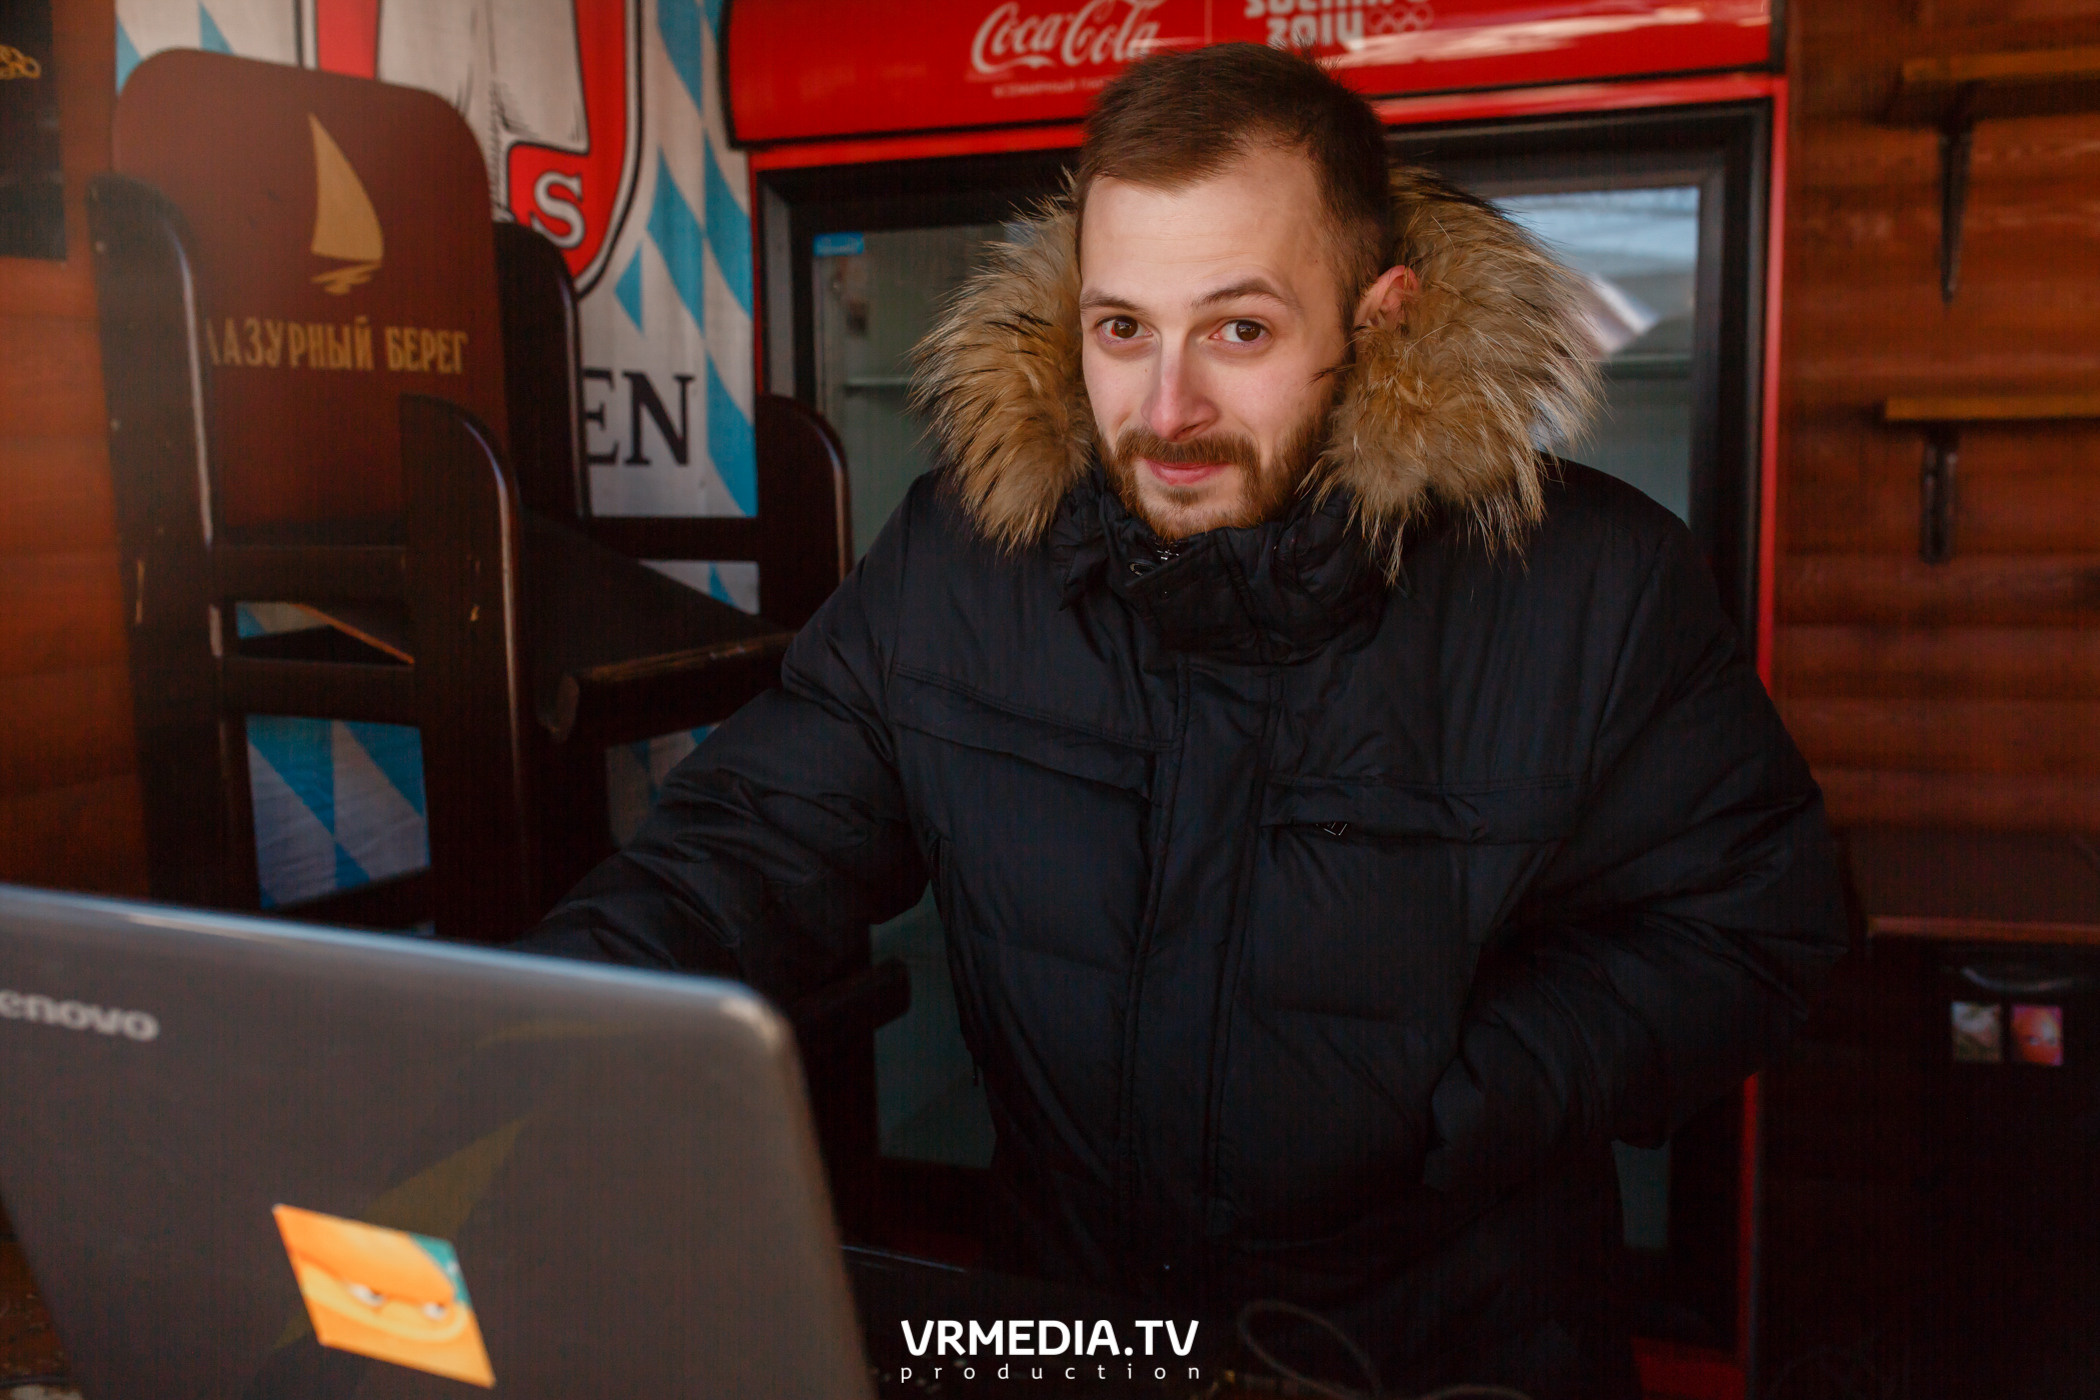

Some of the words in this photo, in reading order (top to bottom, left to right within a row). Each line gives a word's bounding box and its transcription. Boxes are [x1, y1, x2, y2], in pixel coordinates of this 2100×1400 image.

[970, 0, 1160, 73] Coca-Cola
[529, 170, 587, 249] S
[384, 326, 469, 375] БЕРЕГ
